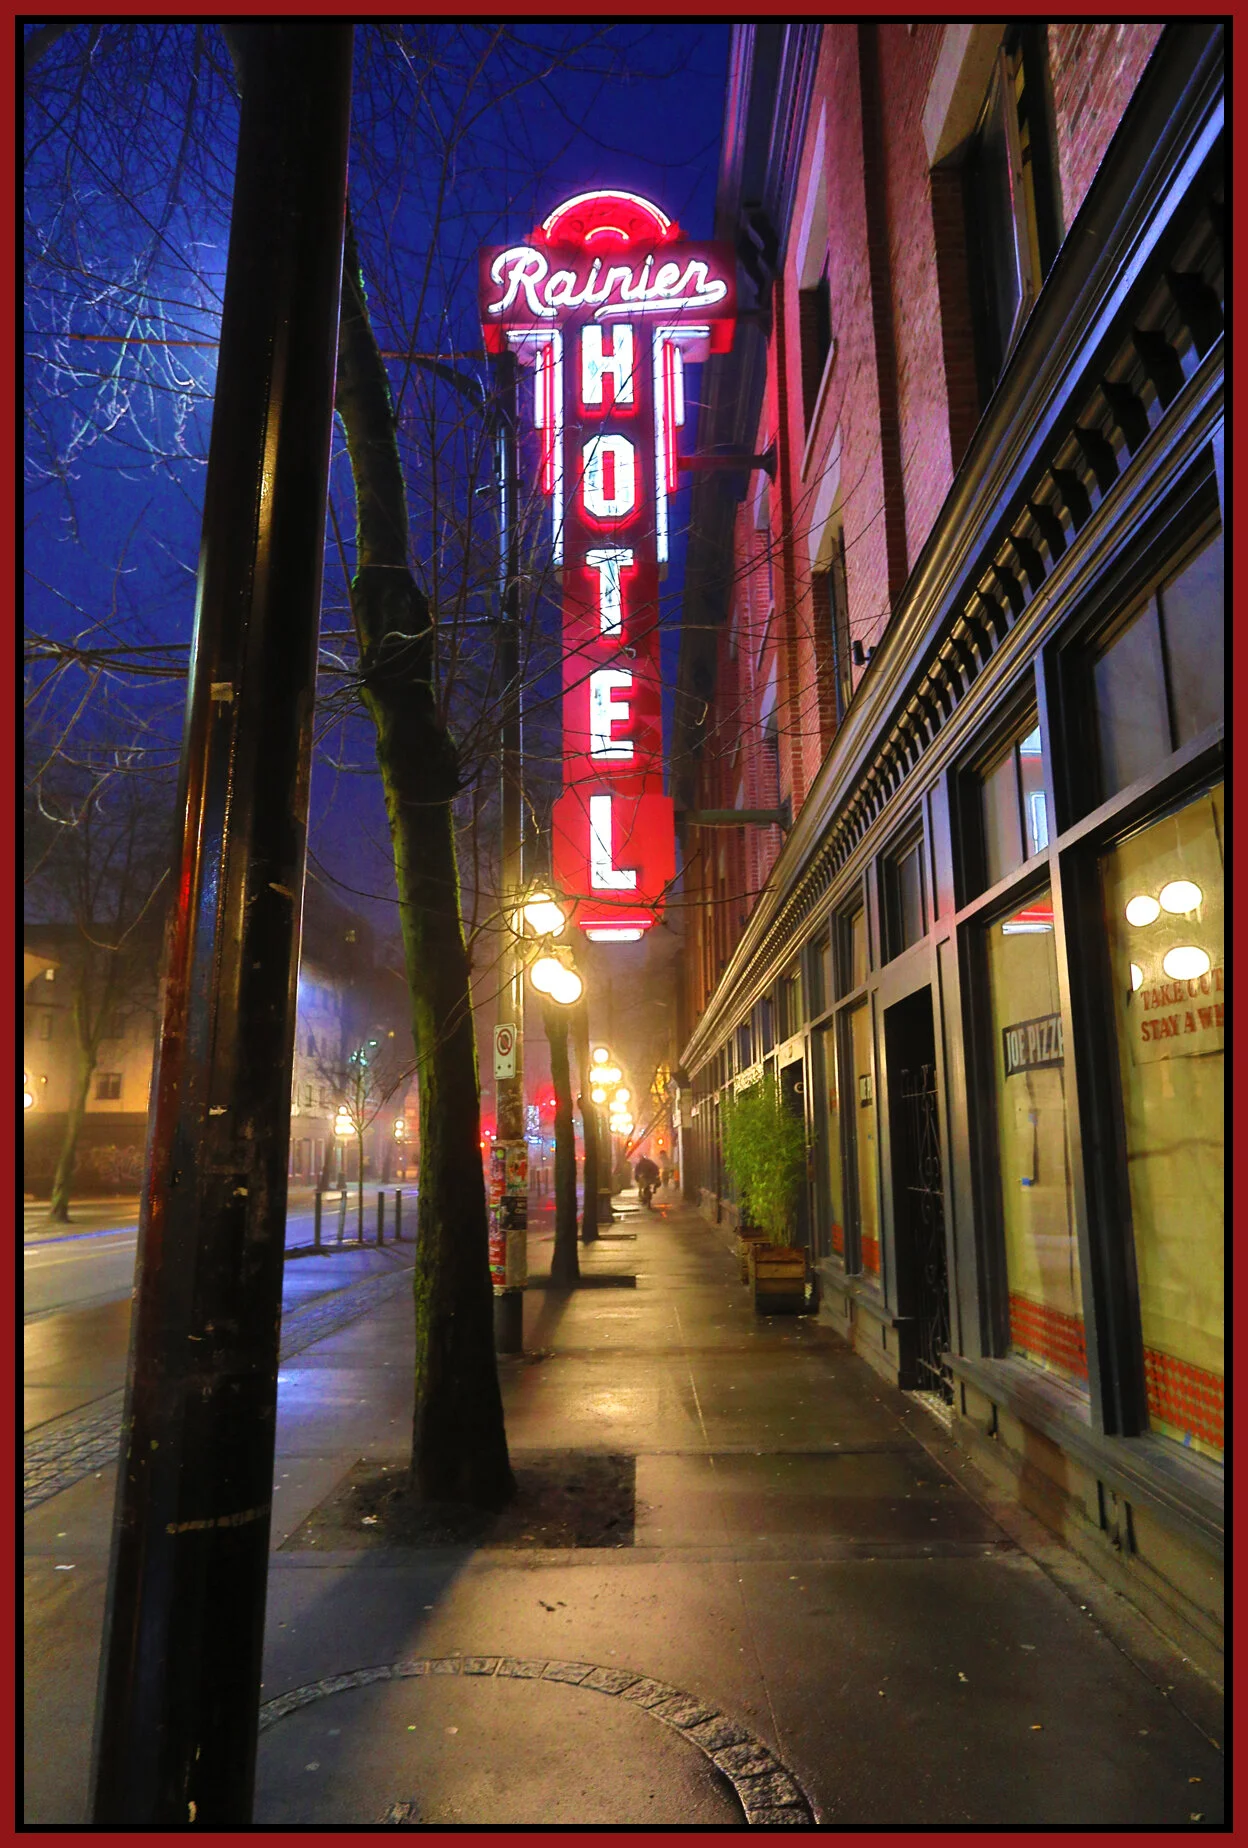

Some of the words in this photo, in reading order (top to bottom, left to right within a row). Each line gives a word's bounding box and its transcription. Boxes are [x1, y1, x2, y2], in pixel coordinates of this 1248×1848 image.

[488, 247, 727, 319] Rainier
[582, 324, 636, 889] HOTEL
[1140, 982, 1184, 1012] TAKE
[1187, 968, 1224, 998] OUT
[1141, 1014, 1181, 1042] STAY
[1184, 1011, 1197, 1034] A
[1006, 1027, 1026, 1073] JOE
